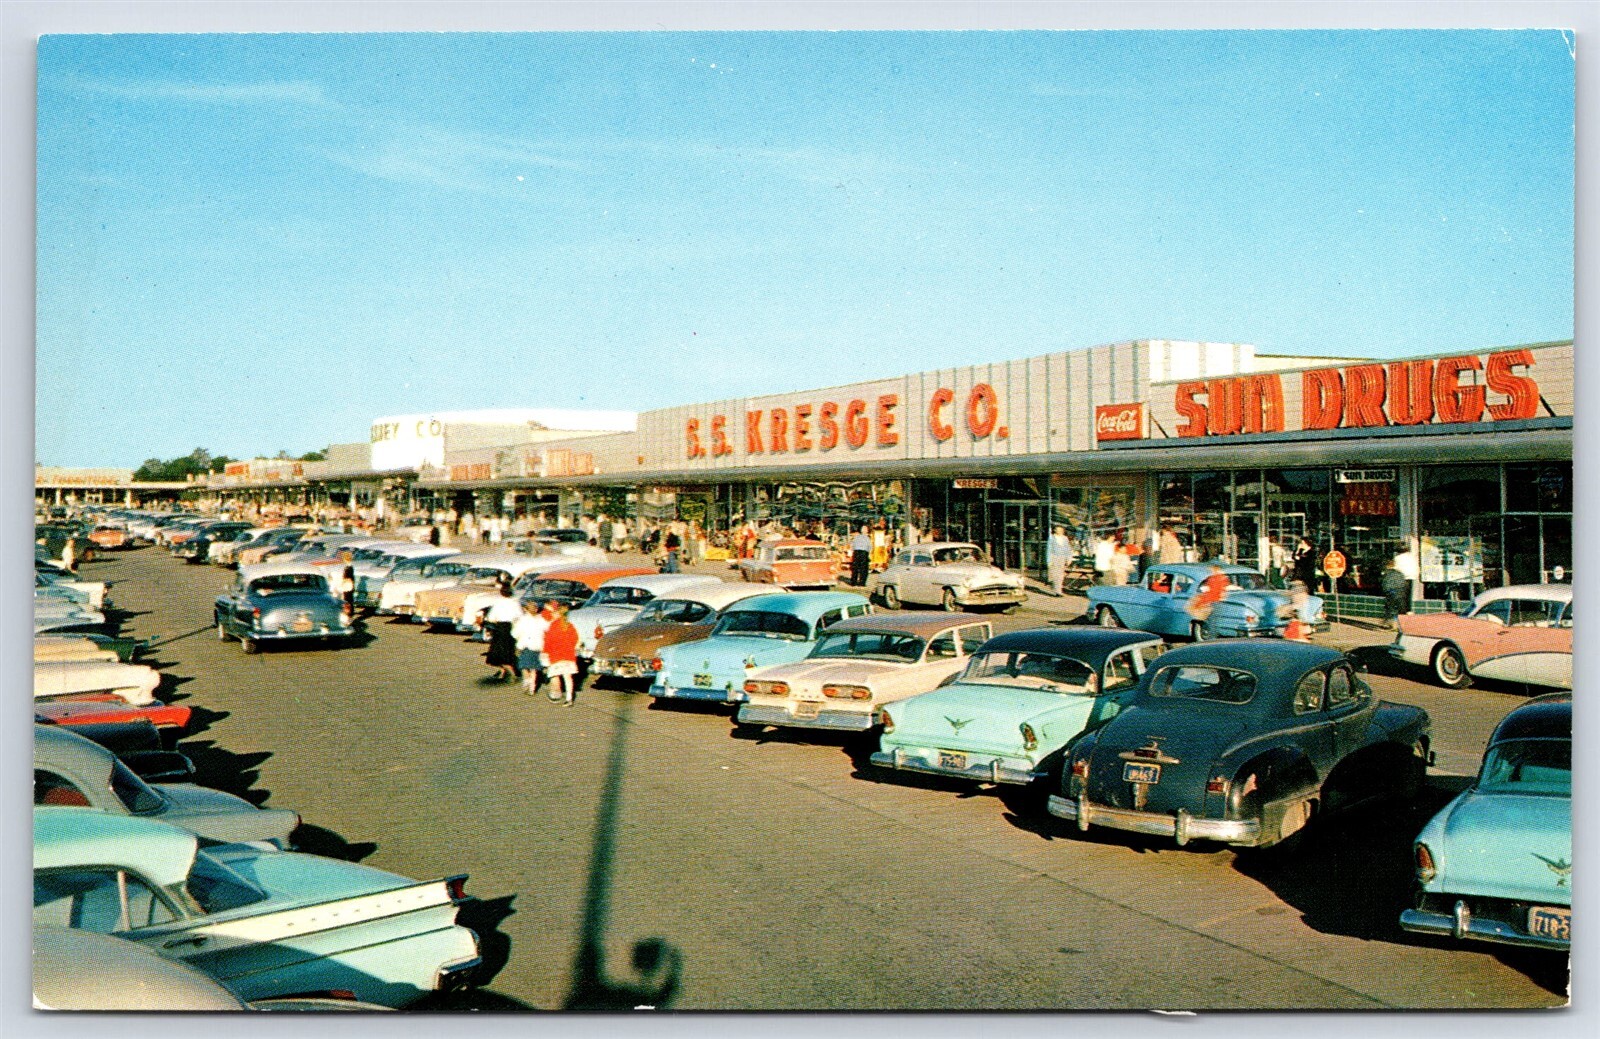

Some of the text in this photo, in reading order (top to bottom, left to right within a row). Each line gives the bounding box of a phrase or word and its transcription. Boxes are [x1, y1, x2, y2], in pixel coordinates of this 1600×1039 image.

[746, 393, 900, 455] KRESGE
[929, 382, 1009, 441] CO.
[1175, 349, 1539, 438] SUN DRUGS
[1364, 470, 1393, 480] DRUGS
